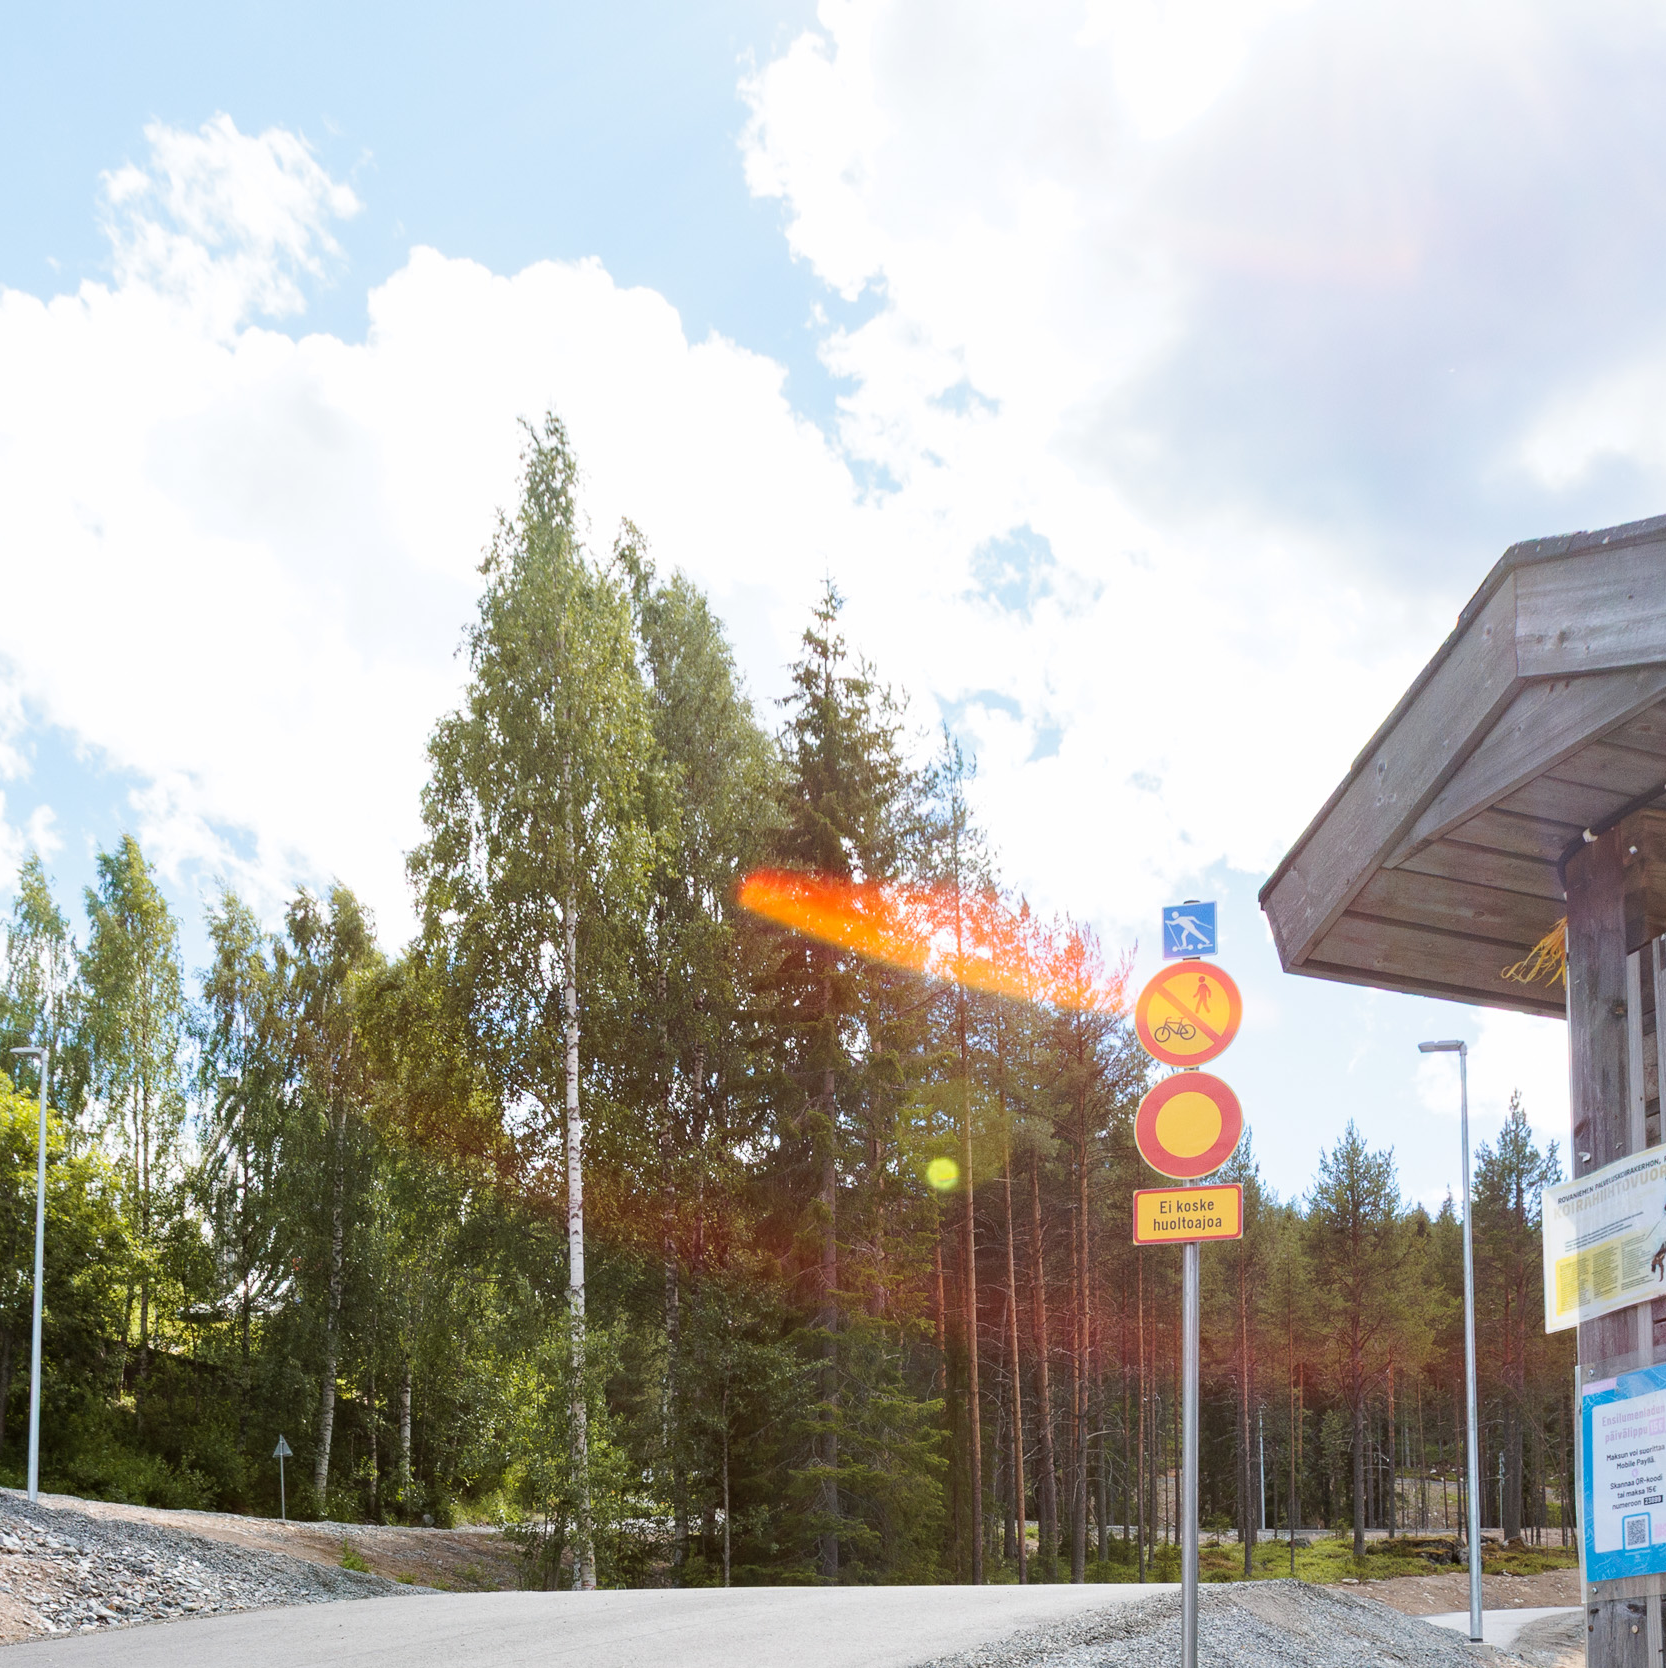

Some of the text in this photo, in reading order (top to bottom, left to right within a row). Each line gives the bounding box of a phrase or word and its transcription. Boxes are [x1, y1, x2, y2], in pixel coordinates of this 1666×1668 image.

[1558, 1186, 1594, 1204] ROVANIEMEN
[1160, 1199, 1215, 1214] Ei koske
[1153, 1215, 1222, 1231] huoltoajoa
[1602, 1405, 1666, 1427] Ensilumenladun
[1605, 1426, 1648, 1445] päivälippu
[1606, 1444, 1666, 1462] Maksun voi suorittaa
[1616, 1460, 1636, 1470] Mobile
[1610, 1473, 1663, 1490] Skannaa QR-koodi
[1617, 1485, 1658, 1499] tai maksa 15€
[1612, 1500, 1642, 1511] numeroon
